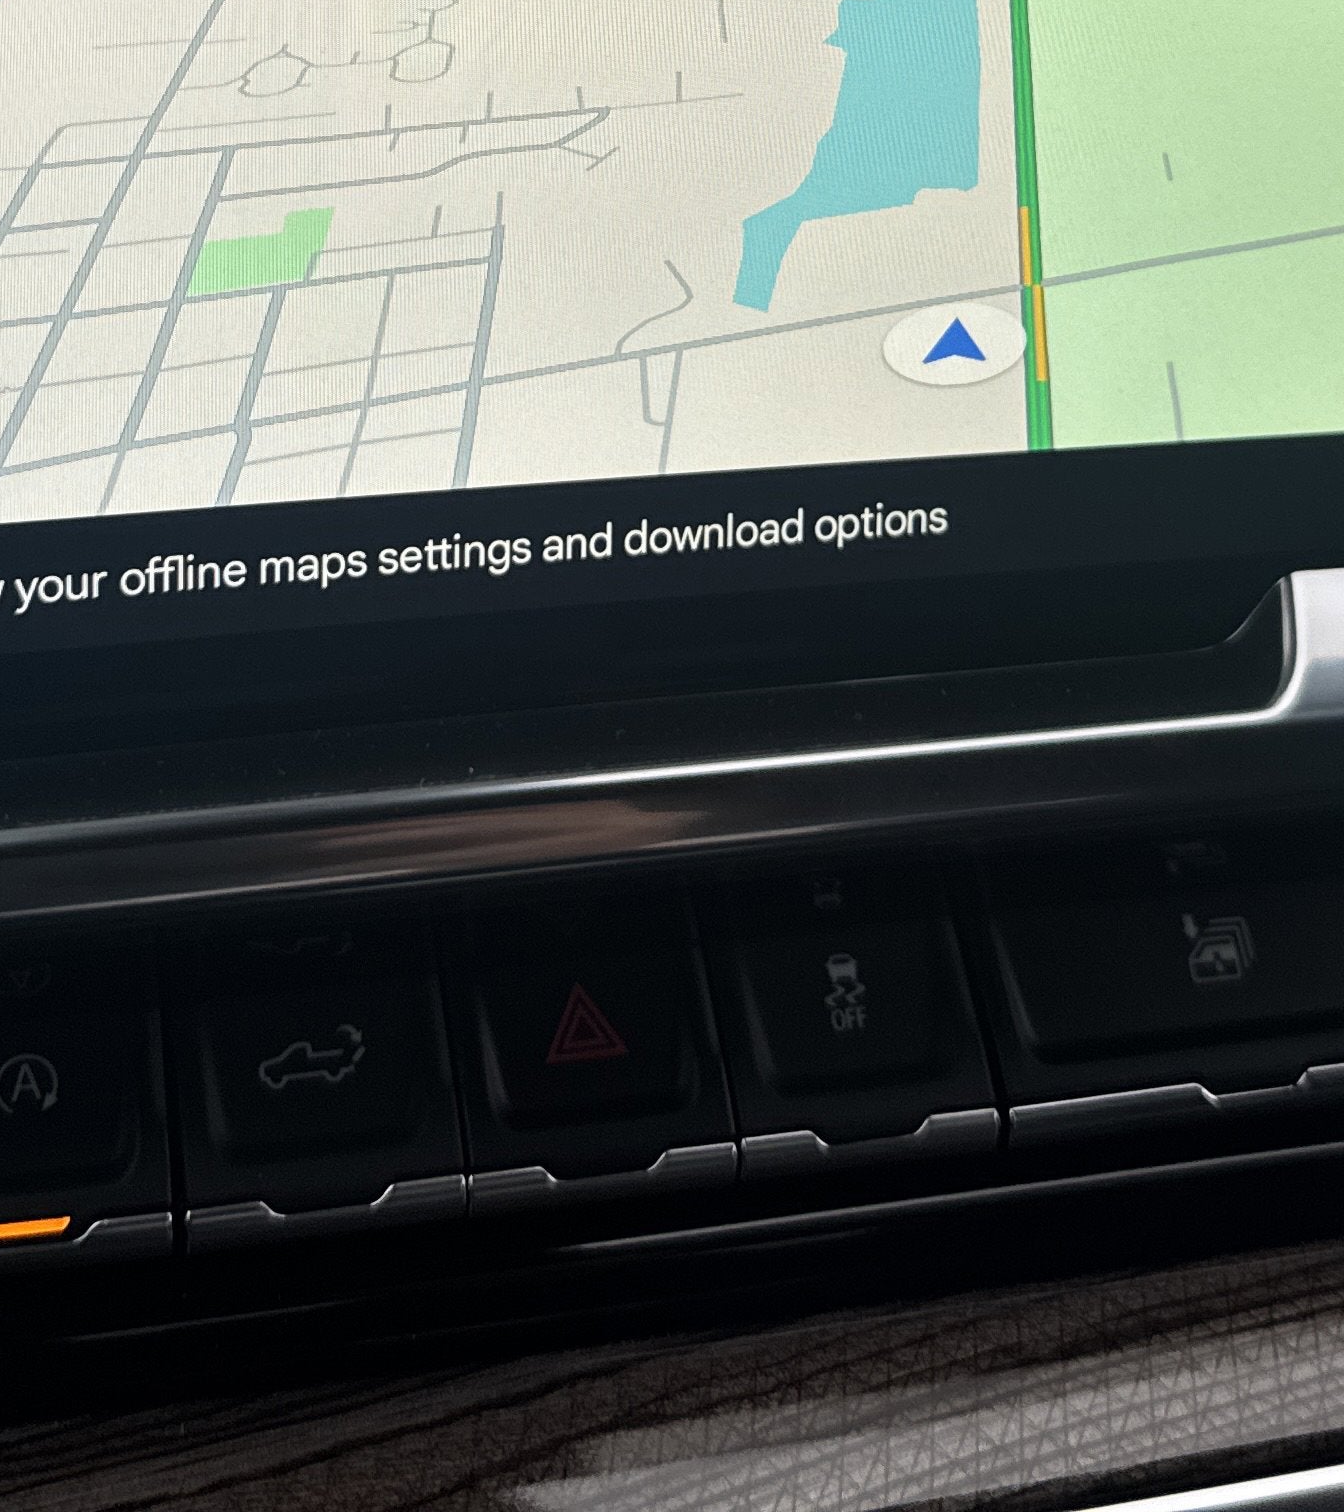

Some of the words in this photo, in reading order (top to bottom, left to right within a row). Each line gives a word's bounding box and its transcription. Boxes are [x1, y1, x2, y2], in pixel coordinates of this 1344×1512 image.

[13, 570, 109, 616] your
[118, 552, 249, 597] offline
[259, 549, 369, 590] maps
[377, 531, 533, 577] settings
[541, 520, 614, 564] and
[622, 506, 805, 557] download
[813, 501, 949, 550] options
